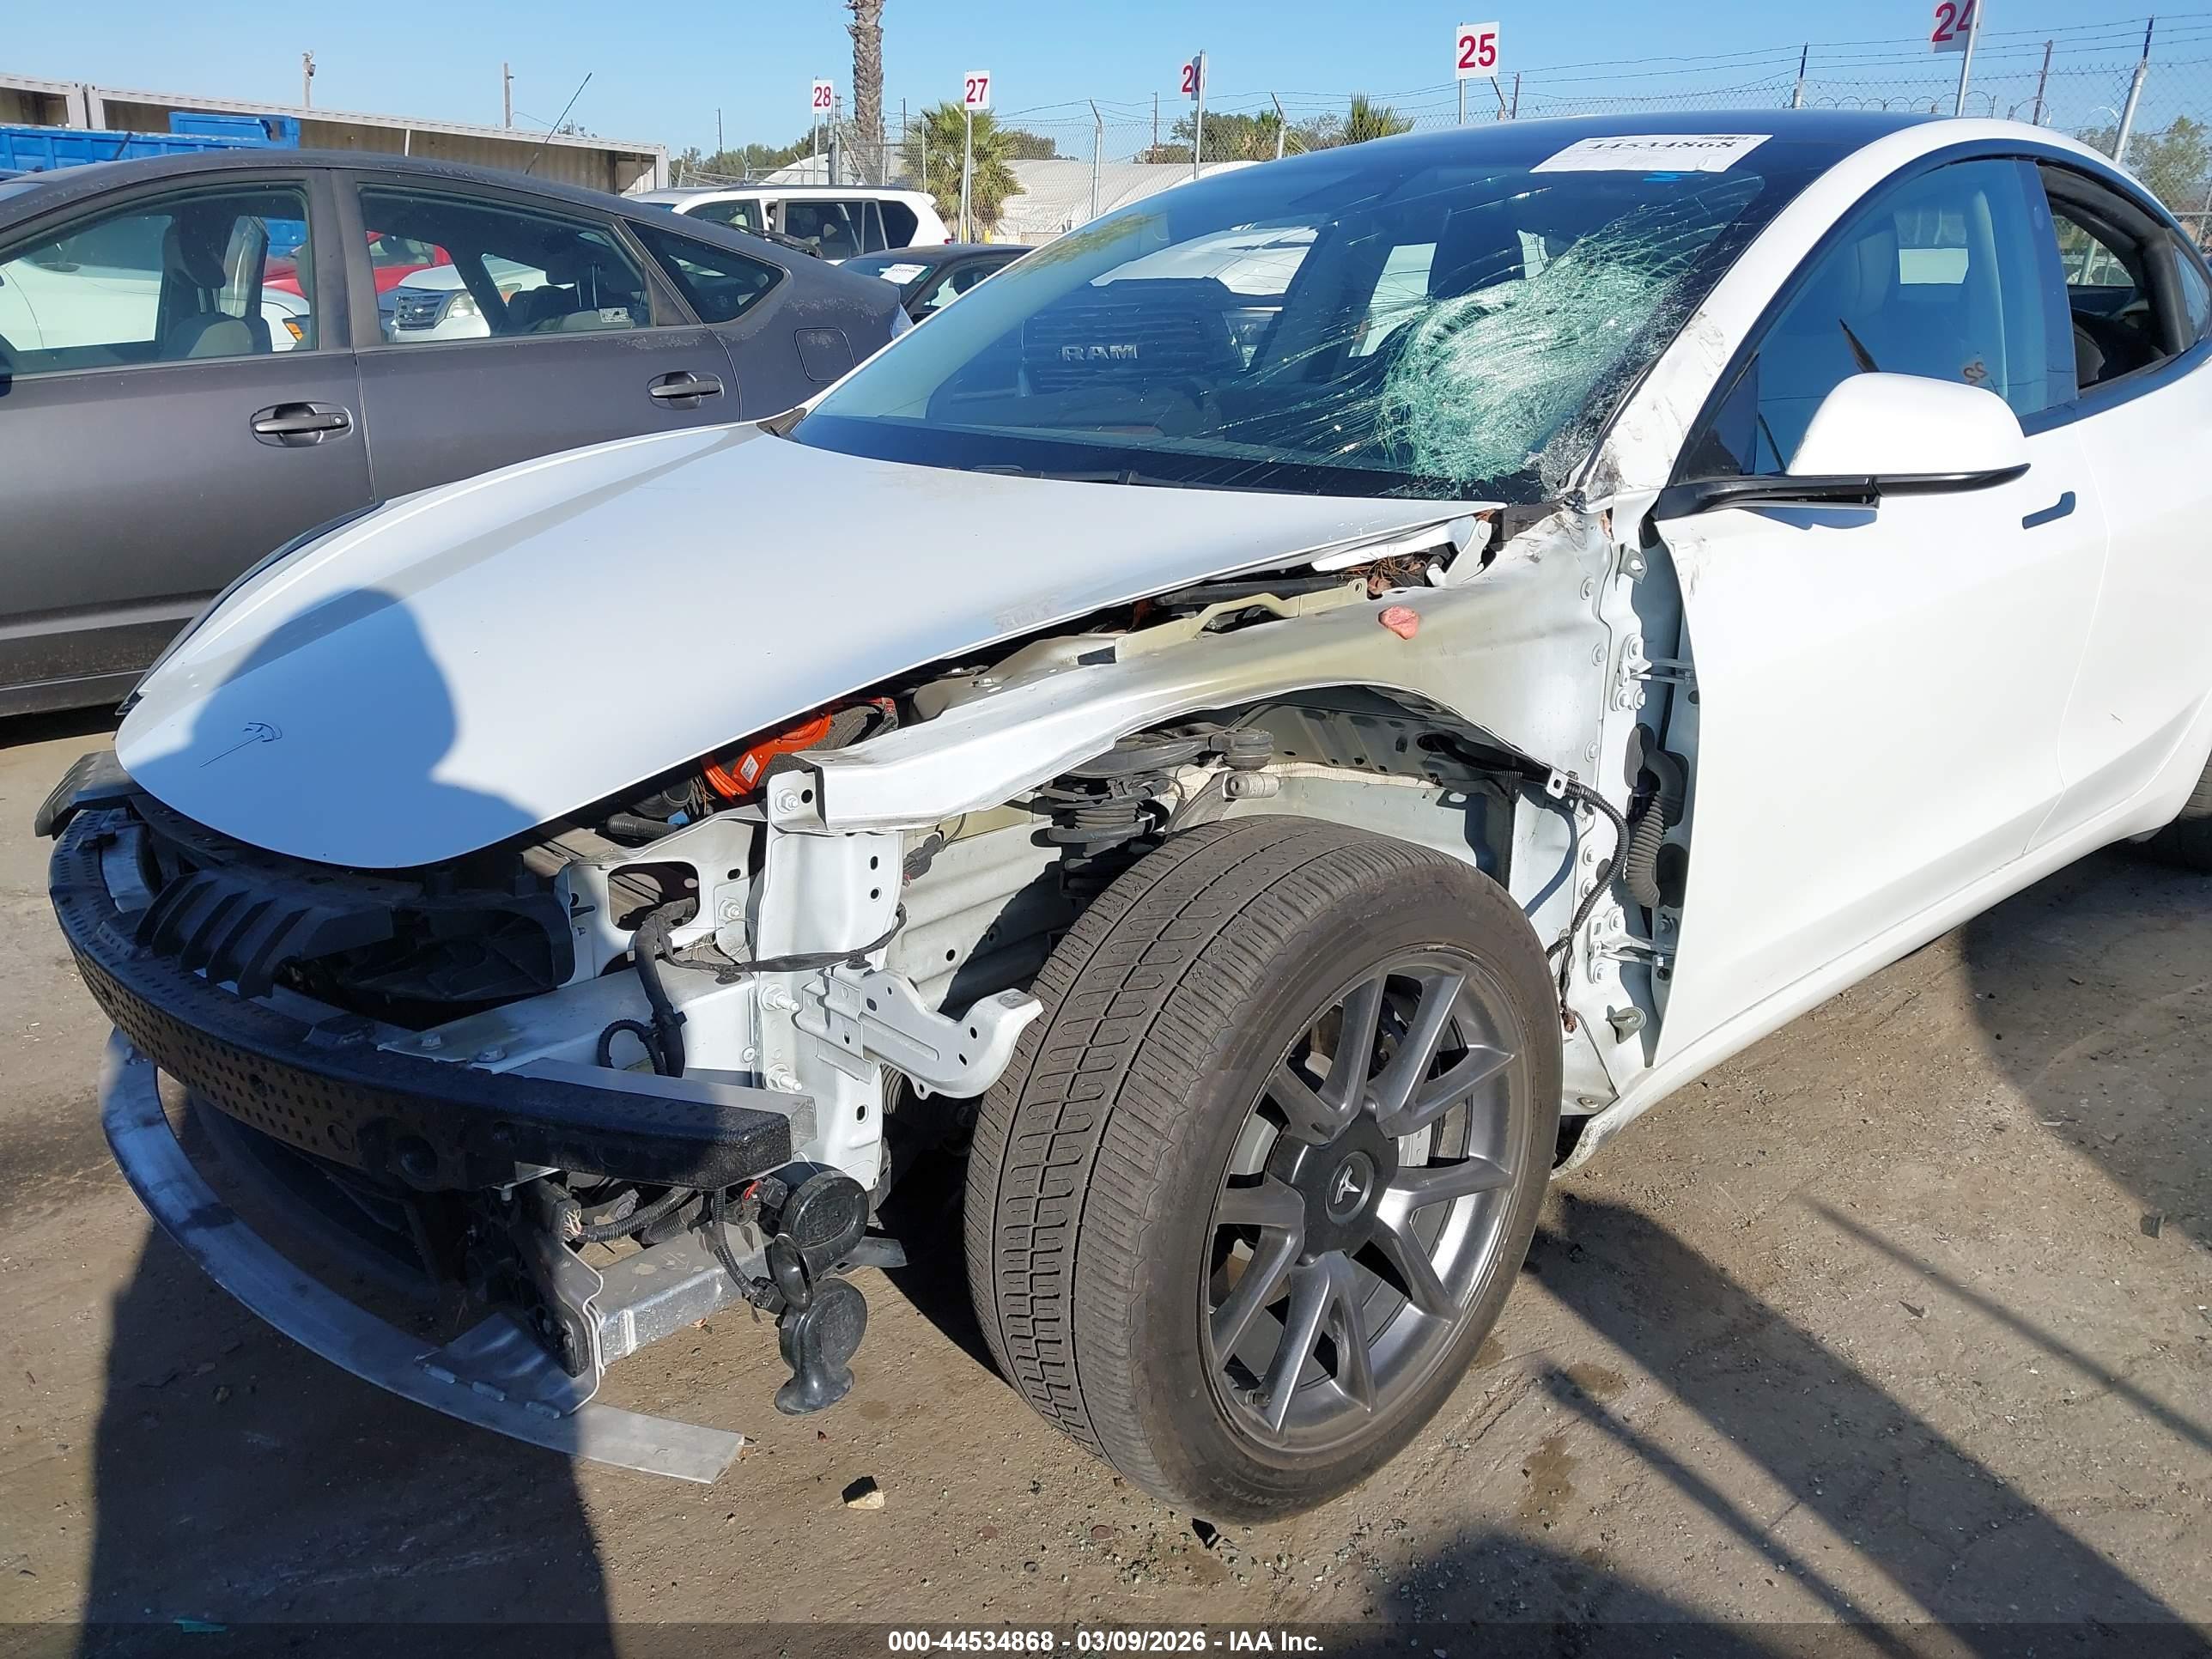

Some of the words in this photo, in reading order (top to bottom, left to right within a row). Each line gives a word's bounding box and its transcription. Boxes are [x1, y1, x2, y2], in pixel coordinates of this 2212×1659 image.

[1458, 33, 1496, 69] 25
[813, 86, 831, 107] 28
[965, 78, 988, 103] 27
[1061, 344, 1138, 361] RAM
